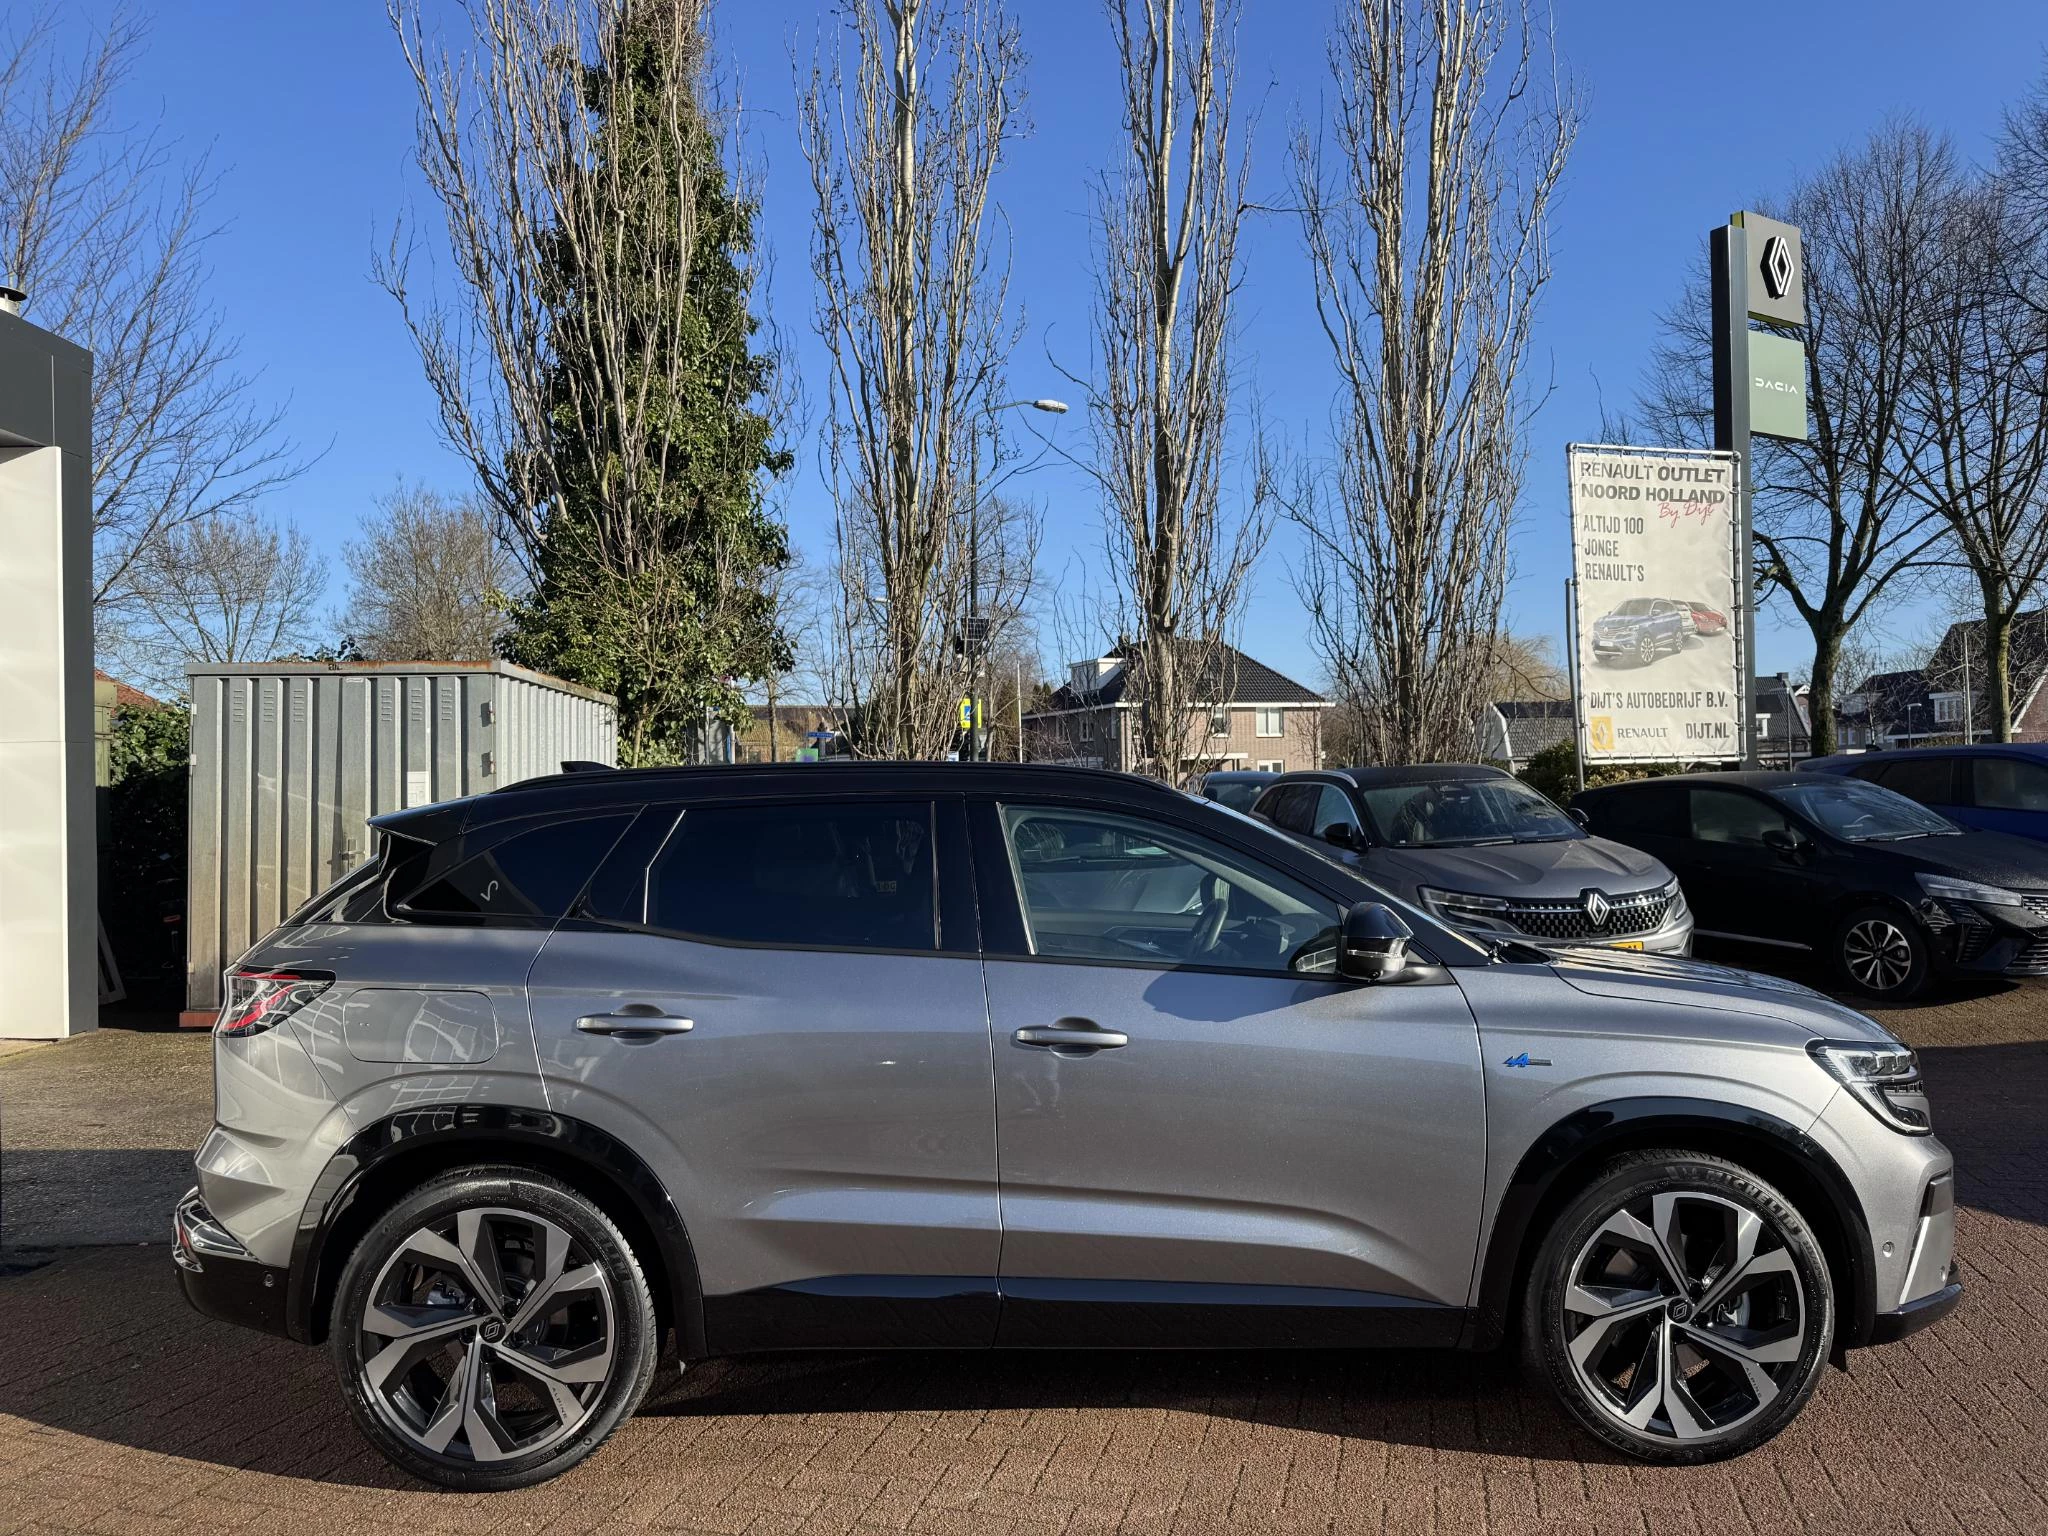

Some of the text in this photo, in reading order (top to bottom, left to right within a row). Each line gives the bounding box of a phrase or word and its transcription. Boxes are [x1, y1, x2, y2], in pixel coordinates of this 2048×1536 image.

[1755, 377, 1798, 394] DACIA
[1580, 462, 1725, 483] RENAULT OUTLET
[1581, 483, 1725, 504] NOORD HOLLAND
[1583, 515, 1643, 534] ALTIJD 100
[1585, 539, 1619, 557] JONGE
[1585, 563, 1644, 582] RENAULT'S
[1590, 691, 1728, 709] DIJT'S AUTOBEDRIJF B.V.
[1617, 723, 1730, 739] RENAULT DIJT.NL
[1706, 1169, 1802, 1235] MICHELIN
